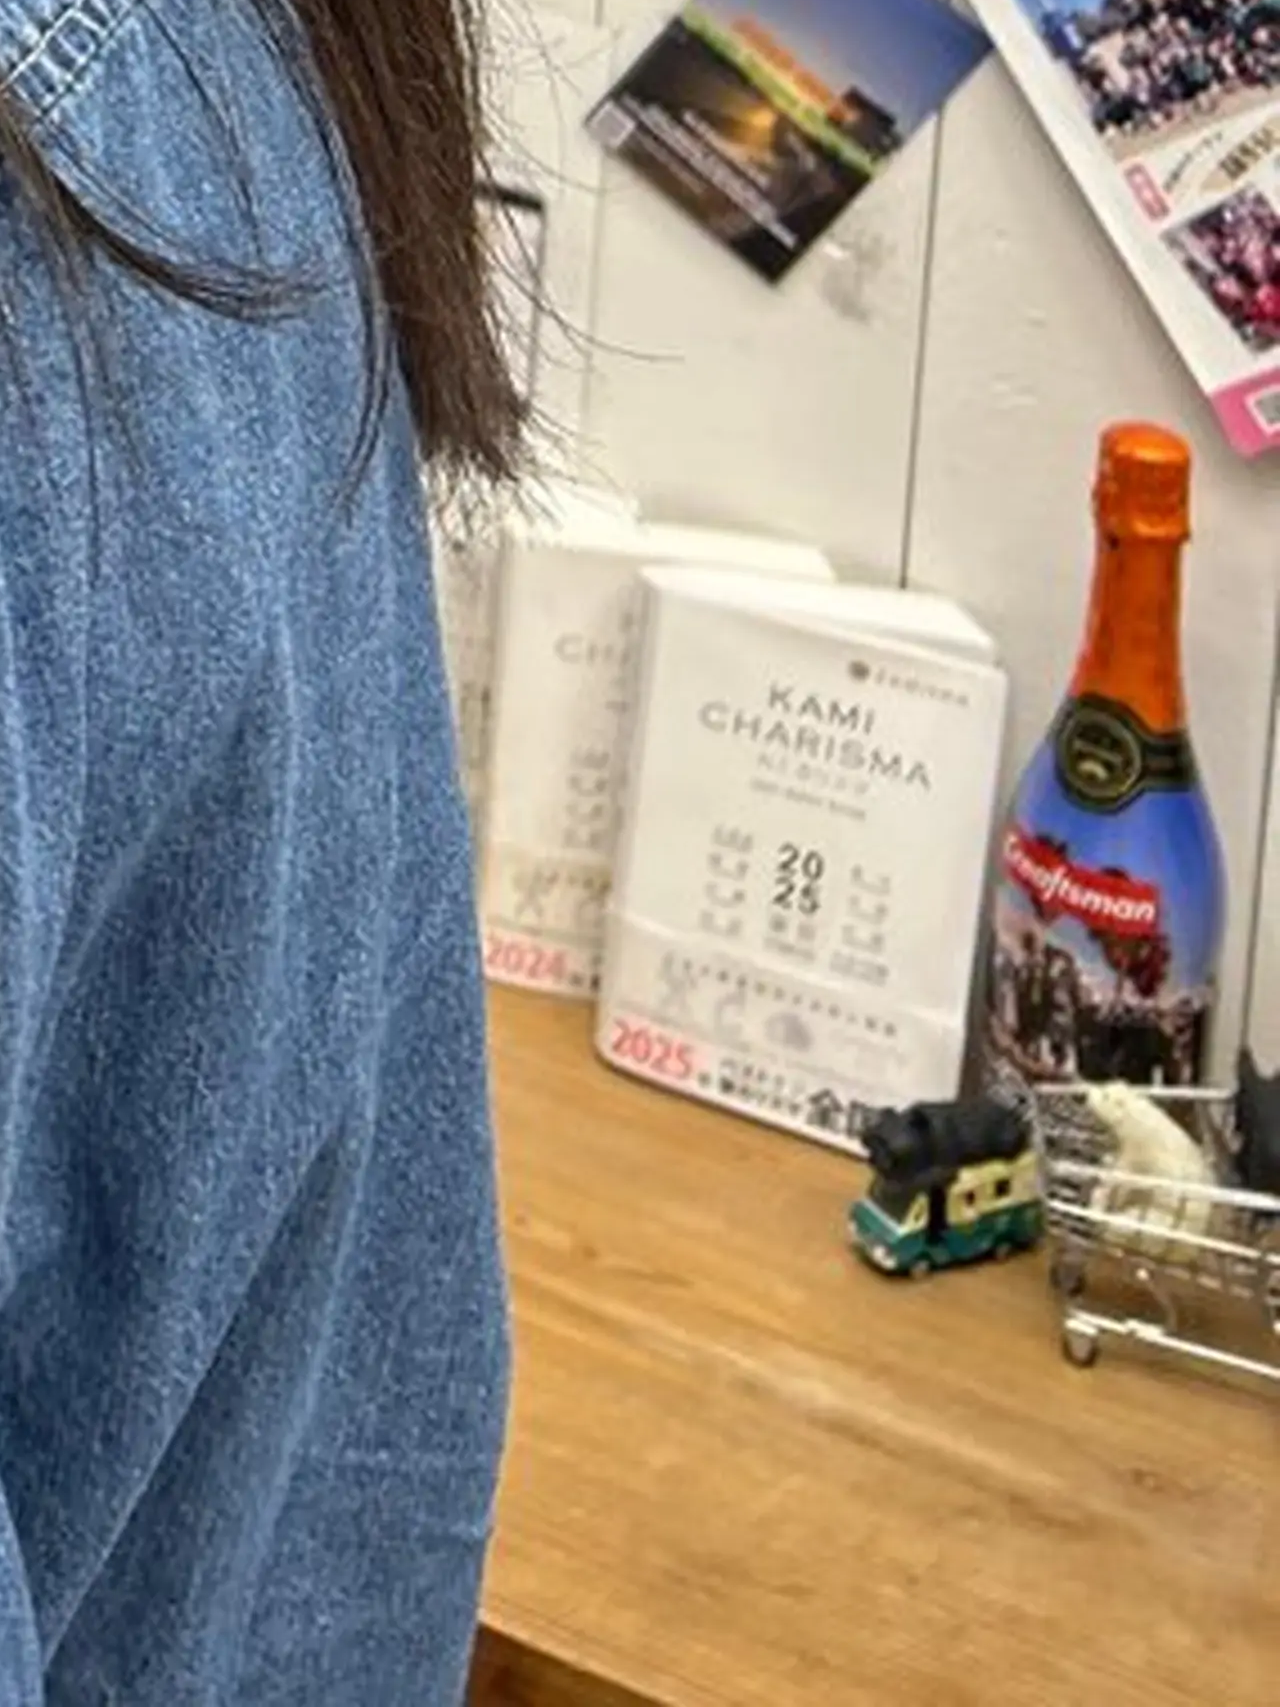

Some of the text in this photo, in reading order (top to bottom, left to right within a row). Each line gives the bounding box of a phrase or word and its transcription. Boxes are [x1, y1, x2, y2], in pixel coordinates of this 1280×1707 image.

[768, 684, 876, 735] KAMI
[698, 700, 932, 791] CHARISMA
[775, 841, 825, 883] 20
[772, 876, 822, 915] 25
[610, 1016, 695, 1081] 2025
